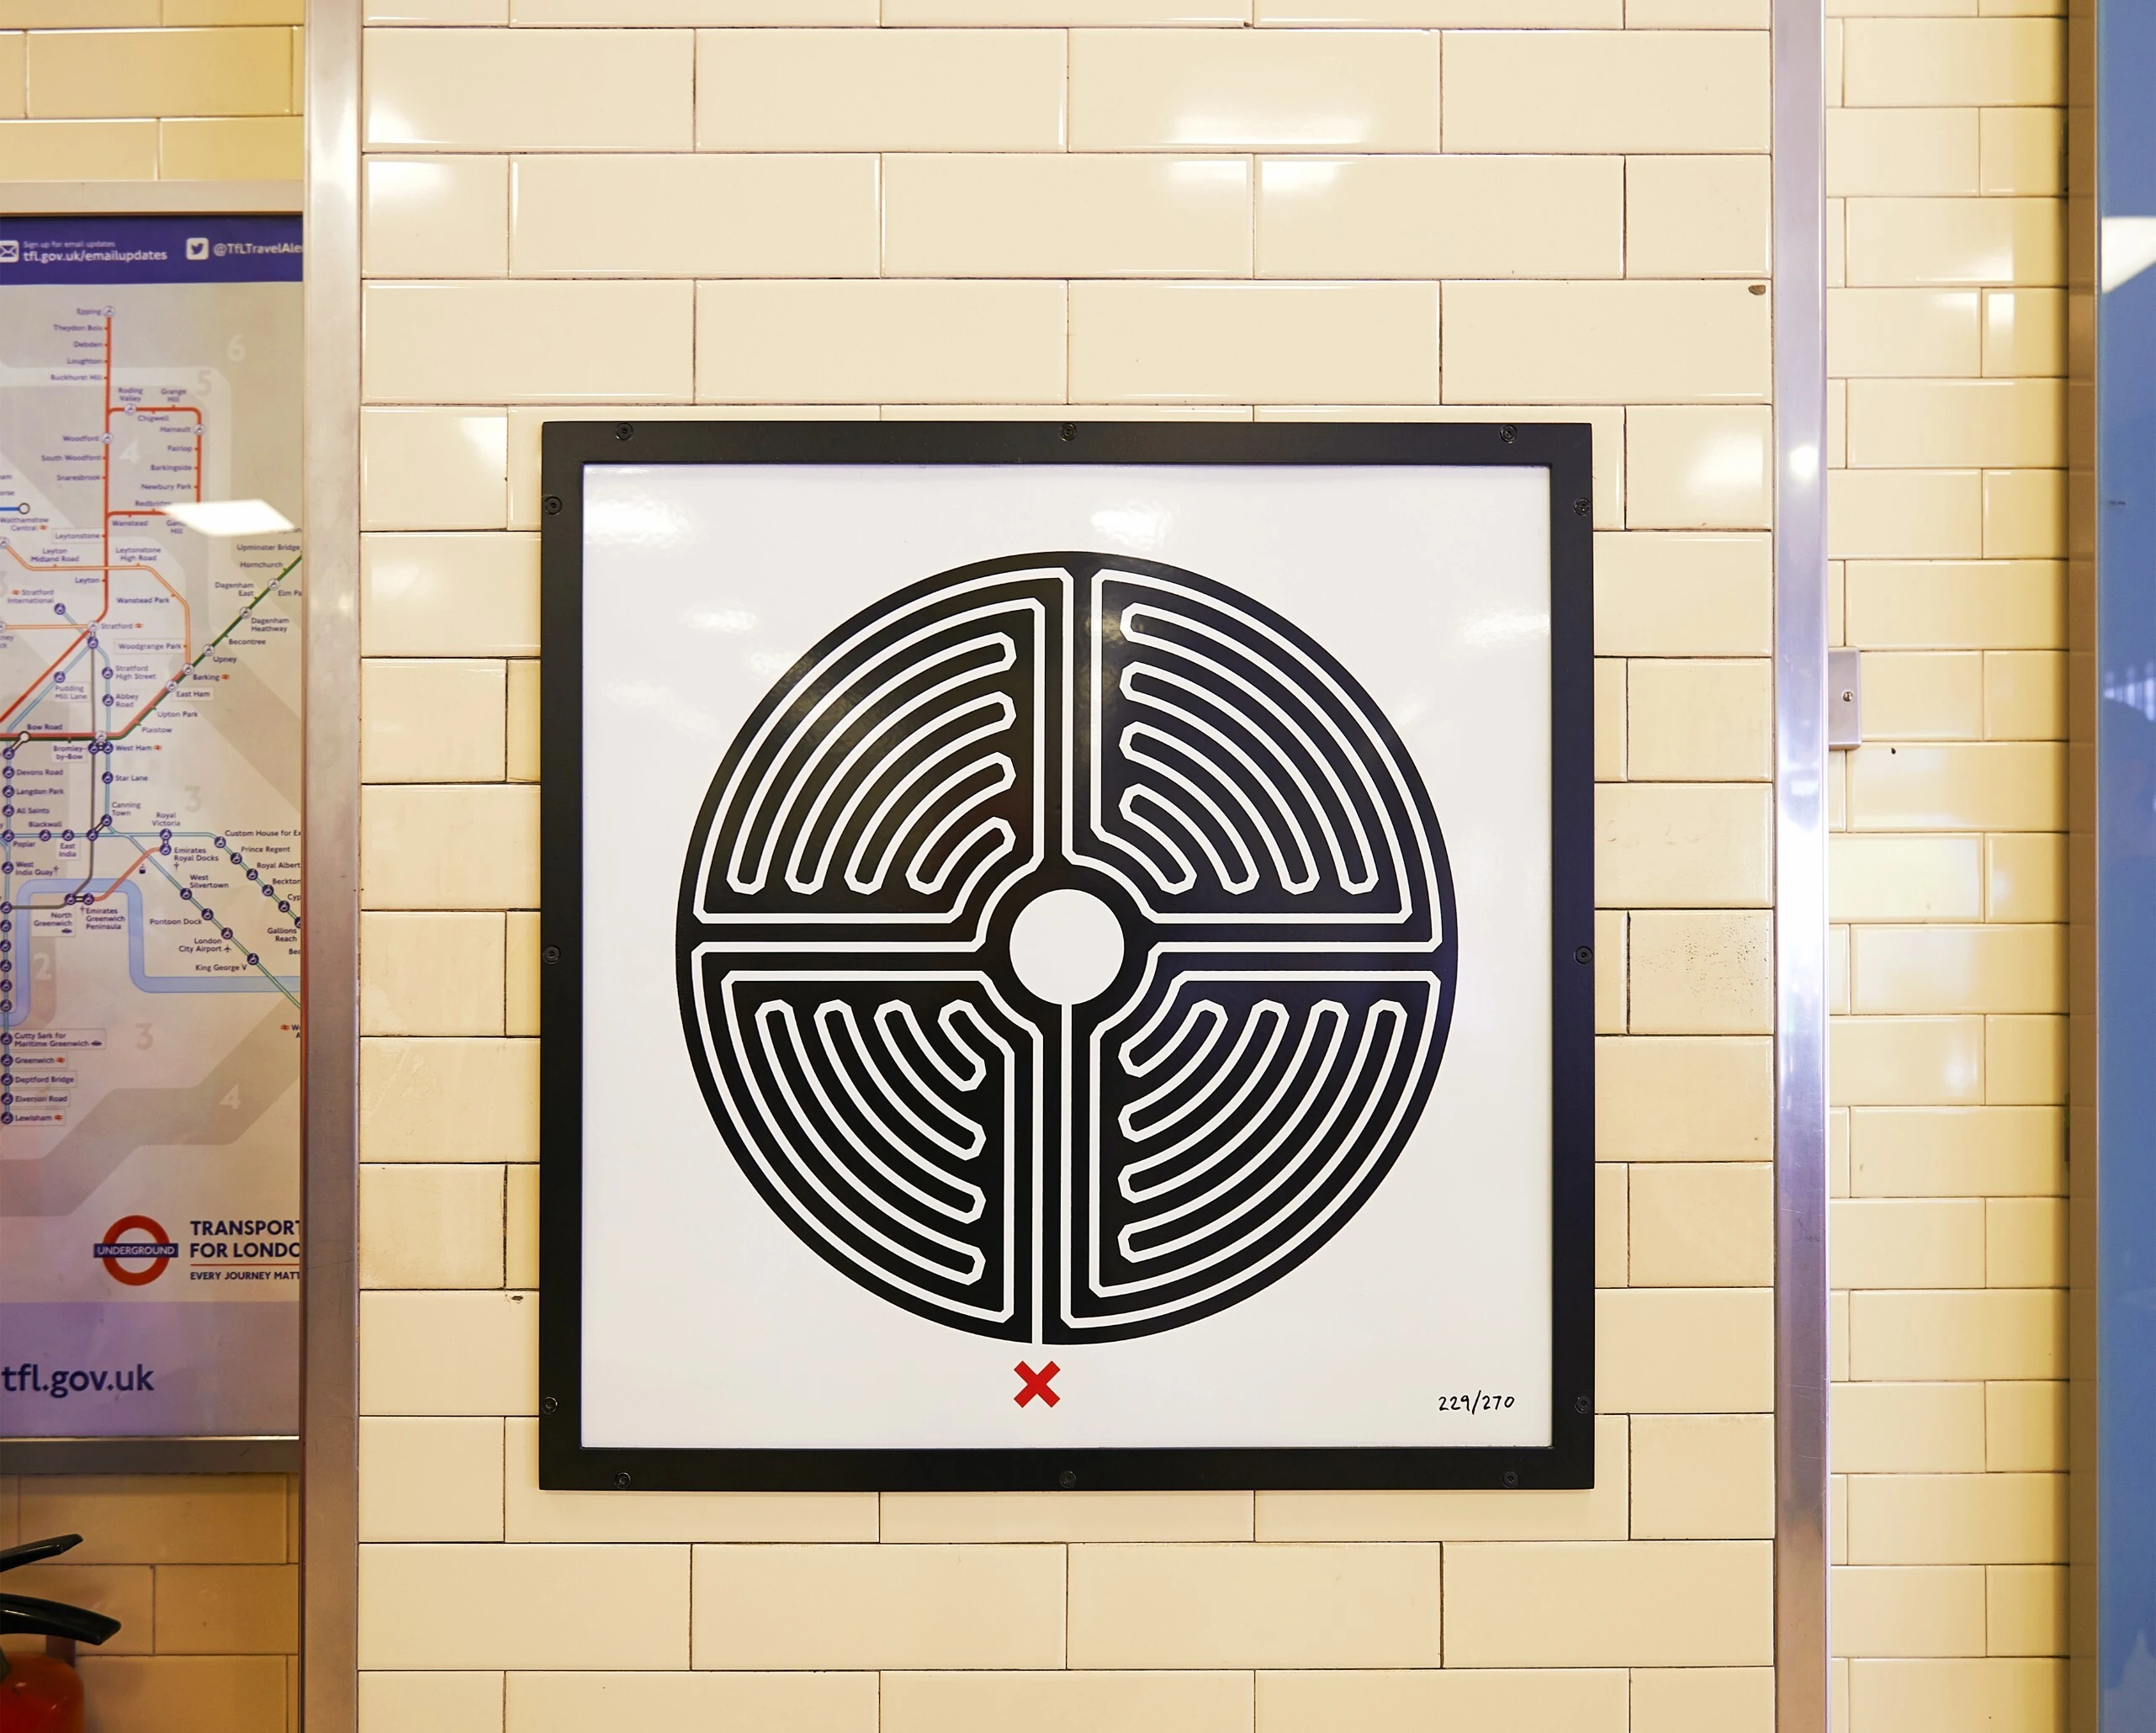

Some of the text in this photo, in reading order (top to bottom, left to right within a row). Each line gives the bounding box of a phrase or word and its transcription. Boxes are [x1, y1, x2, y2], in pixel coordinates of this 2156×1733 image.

[24, 251, 167, 263] tfl.gov.uk/emailupdates
[228, 334, 246, 362] 6
[67, 358, 103, 366] Loughton
[119, 438, 140, 463] 4
[252, 625, 287, 633] Heathway
[119, 643, 163, 651] Woodgrange
[213, 656, 236, 665] Upney
[193, 674, 220, 682] Barking
[55, 685, 84, 693] Pudding
[115, 693, 139, 702] Abbey
[157, 711, 179, 719] Upton
[16, 788, 45, 797] Langdon
[112, 802, 141, 810] Canning
[156, 812, 177, 820] Royal
[174, 855, 192, 863] Royal
[34, 953, 51, 979] 2
[14, 1032, 35, 1041] Cutty
[135, 1023, 154, 1050] 3
[15, 1076, 75, 1084] Deptford Bridge
[220, 1083, 241, 1110] 4
[98, 1246, 175, 1255] UNDERGROUND
[190, 1243, 228, 1258] FOR
[2, 1364, 155, 1398] tfl.gov.uk
[1438, 1390, 1515, 1415] 229/270
